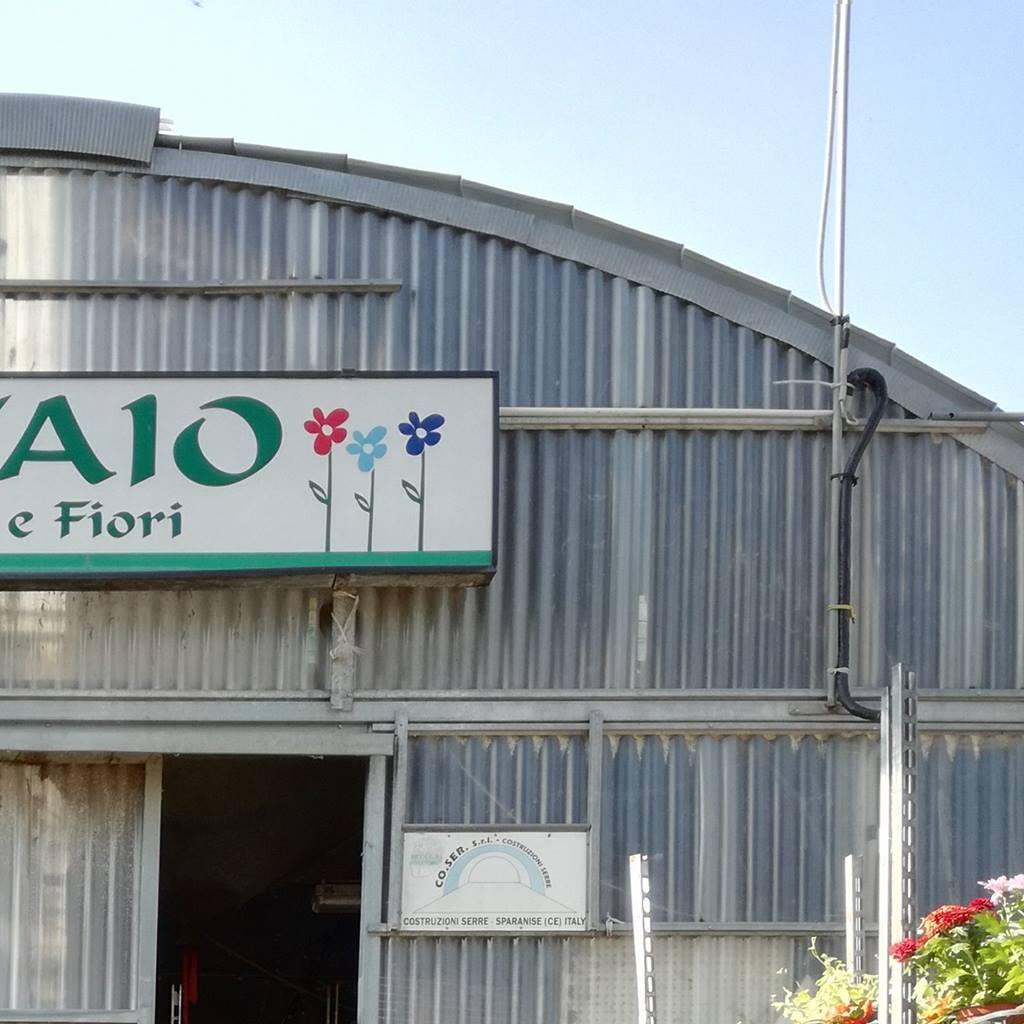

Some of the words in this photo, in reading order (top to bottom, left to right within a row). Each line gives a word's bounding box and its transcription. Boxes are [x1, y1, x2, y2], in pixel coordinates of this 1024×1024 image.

[8, 510, 34, 538] e
[54, 500, 183, 538] Fiori
[502, 838, 543, 867] COSTRUZIONI
[541, 867, 552, 888] SERRE
[403, 917, 459, 926] COSTRUZIONI
[461, 917, 489, 926] SERRE
[495, 917, 543, 926] SPARANISE
[544, 917, 562, 927] (CE)
[564, 917, 586, 926] ITALY
